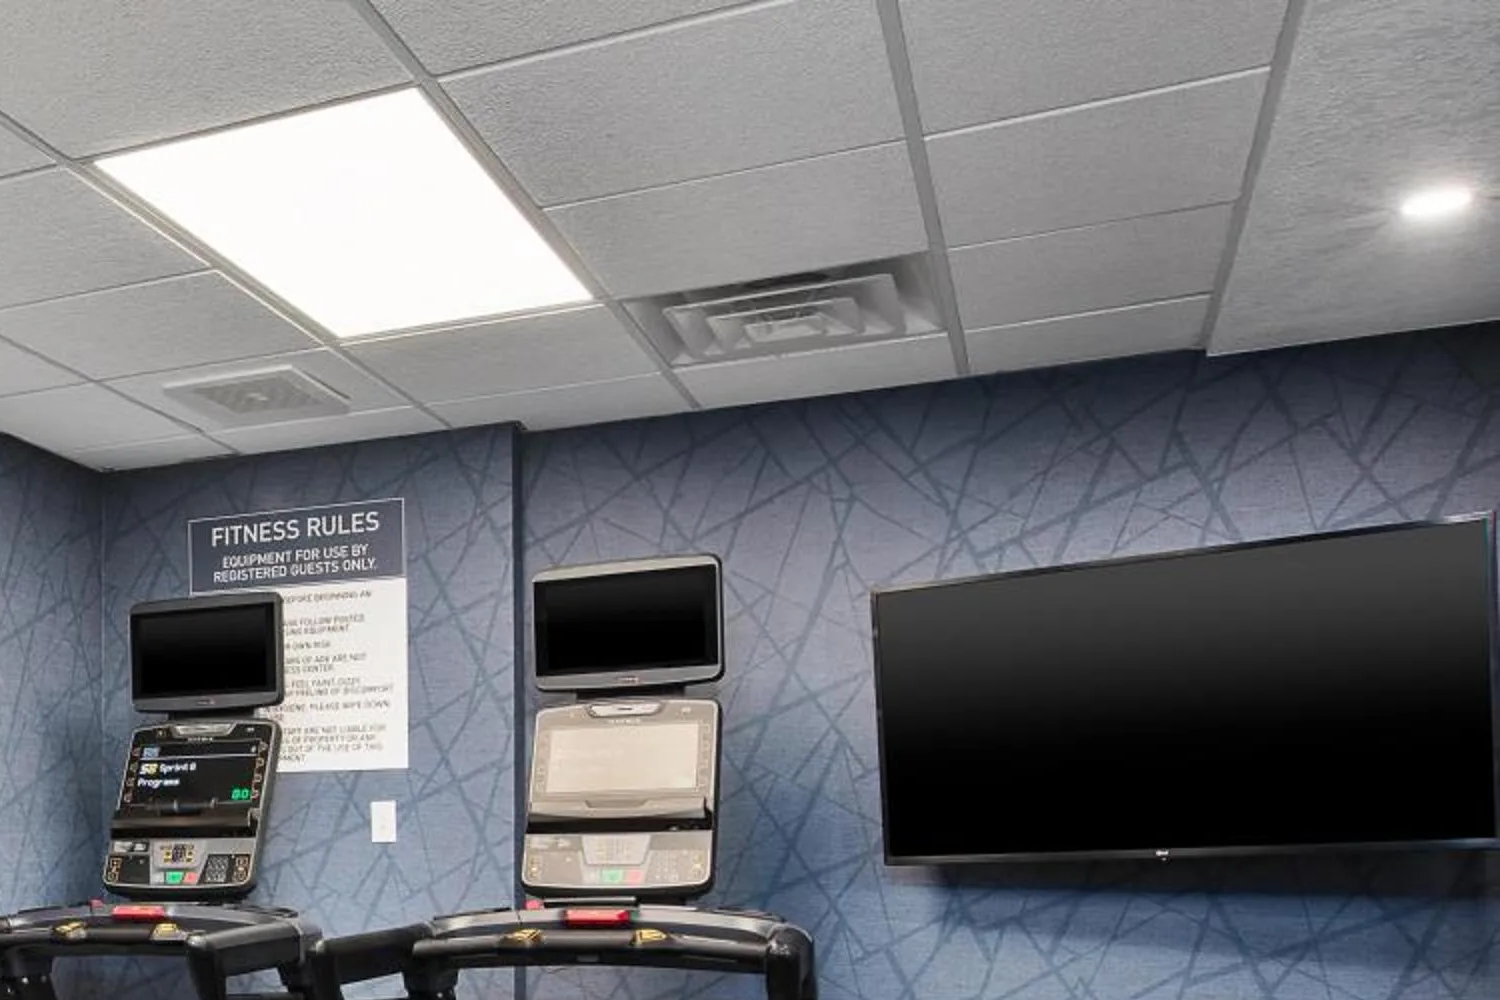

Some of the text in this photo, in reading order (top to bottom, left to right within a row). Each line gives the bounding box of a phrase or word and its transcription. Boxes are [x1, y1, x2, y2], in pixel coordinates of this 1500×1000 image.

[211, 511, 380, 548] FITNESS RULES
[222, 543, 369, 569] EQUIPMENT FOR USE BY
[213, 565, 287, 583] REGISTERED
[290, 561, 340, 577] GUESTS
